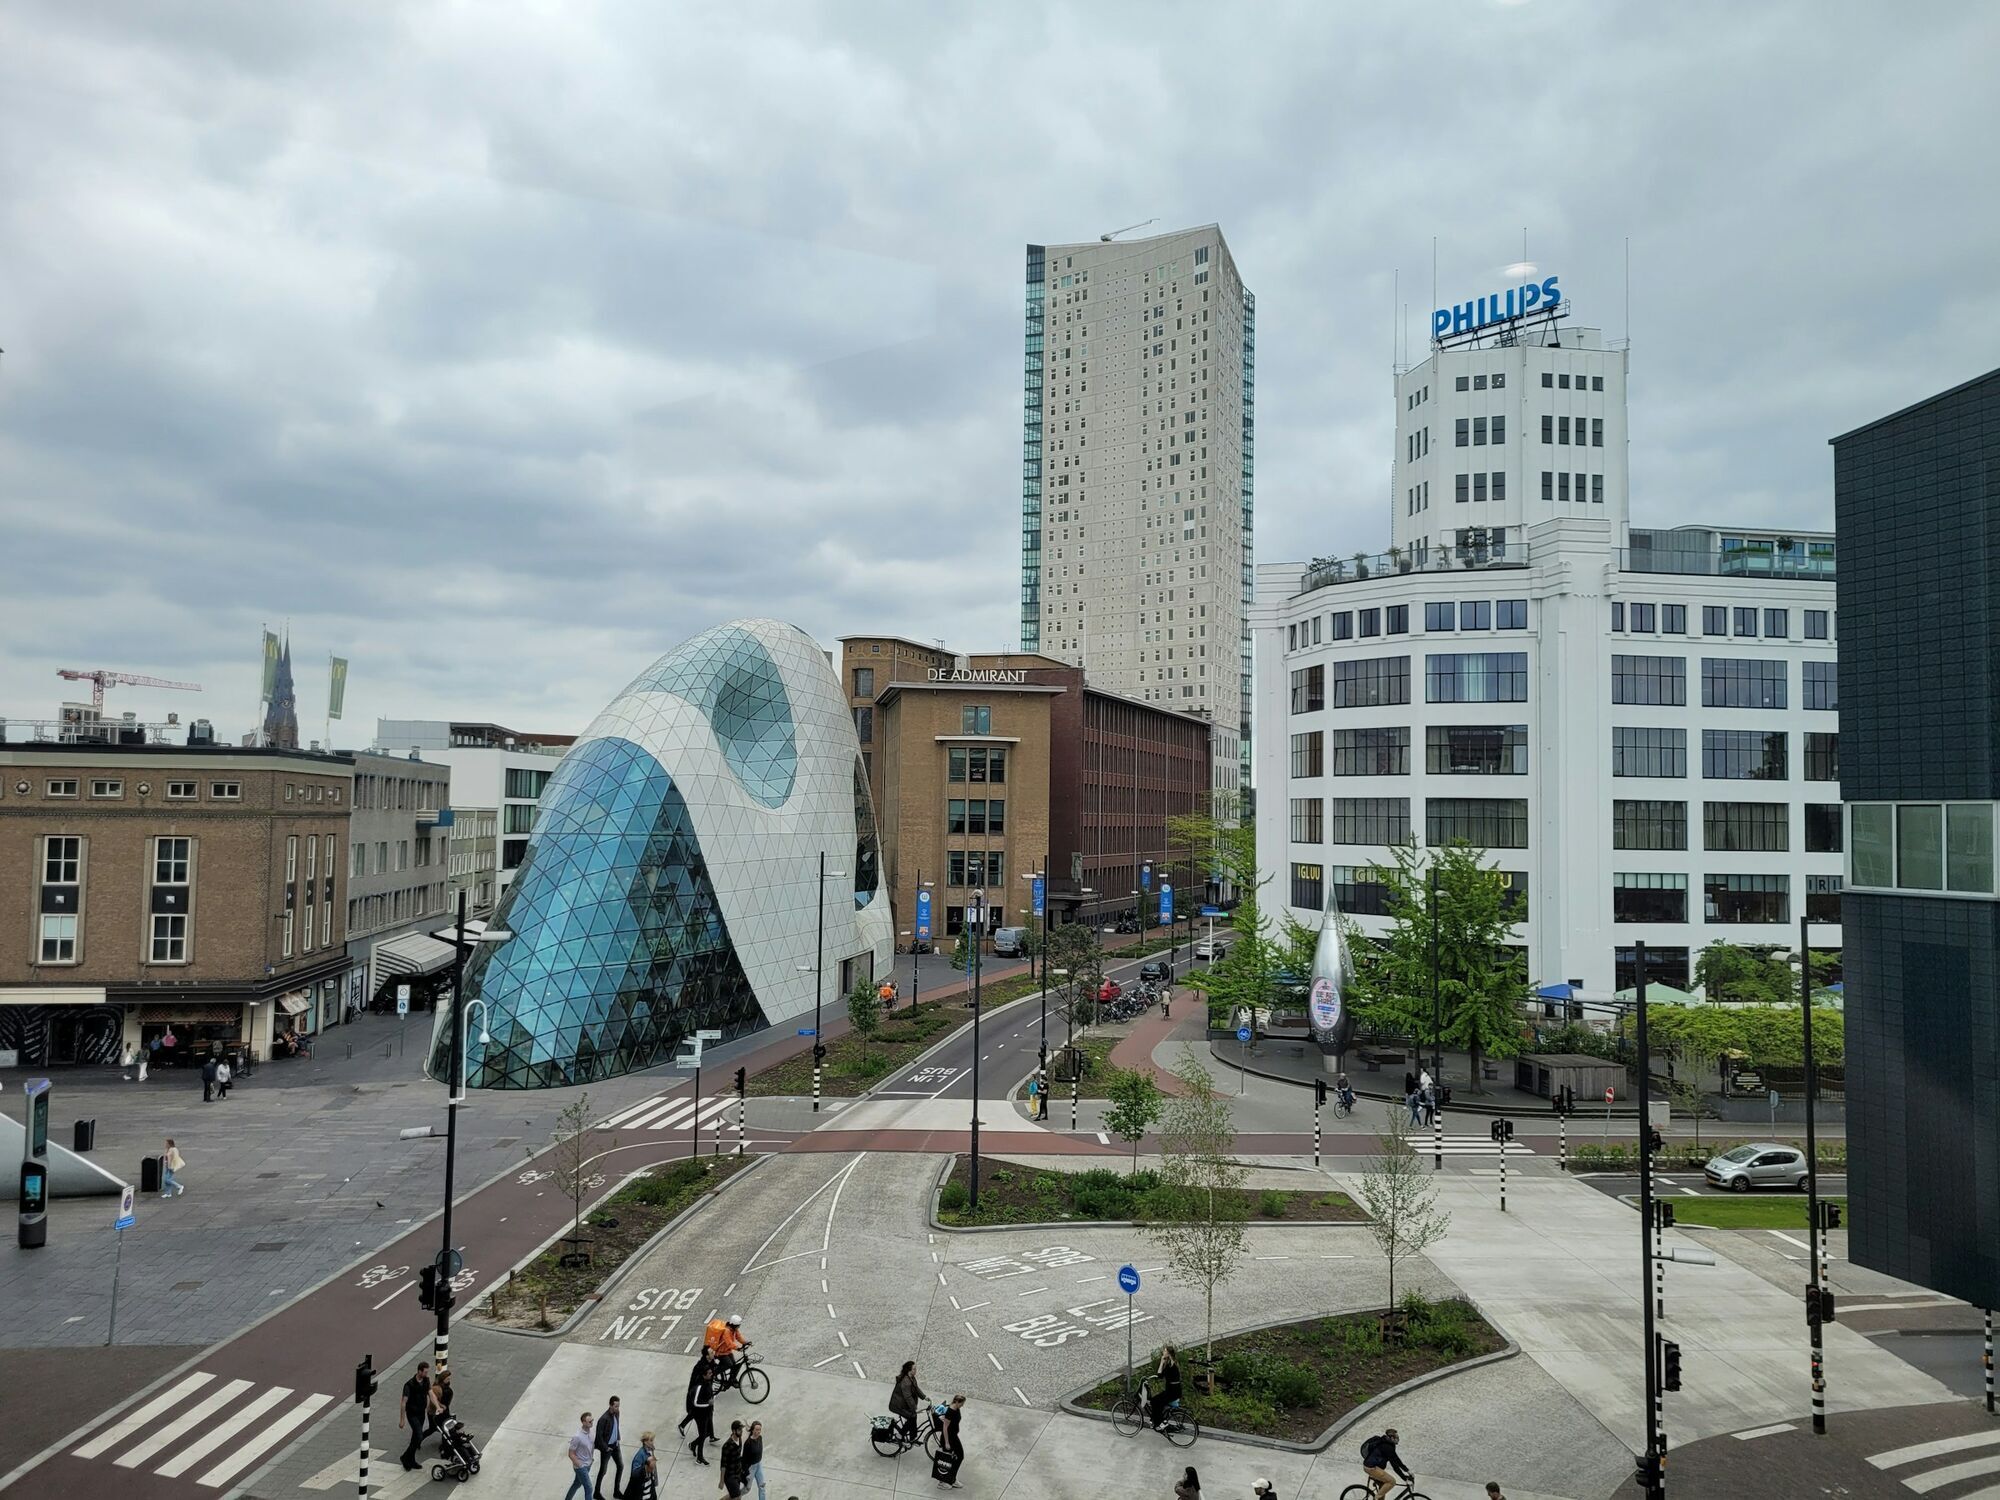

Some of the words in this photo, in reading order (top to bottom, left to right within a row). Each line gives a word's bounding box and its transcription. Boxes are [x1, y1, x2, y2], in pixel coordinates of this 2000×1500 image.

[1432, 276, 1561, 337] PHILIPS
[927, 668, 946, 680] DE
[950, 668, 1027, 683] ADMIRANT
[1298, 864, 1320, 880] IGLUU
[920, 1067, 958, 1075] BUS
[1022, 1246, 1096, 1268] BUS
[629, 1288, 704, 1311] BUS
[1001, 1314, 1090, 1347] BUS
